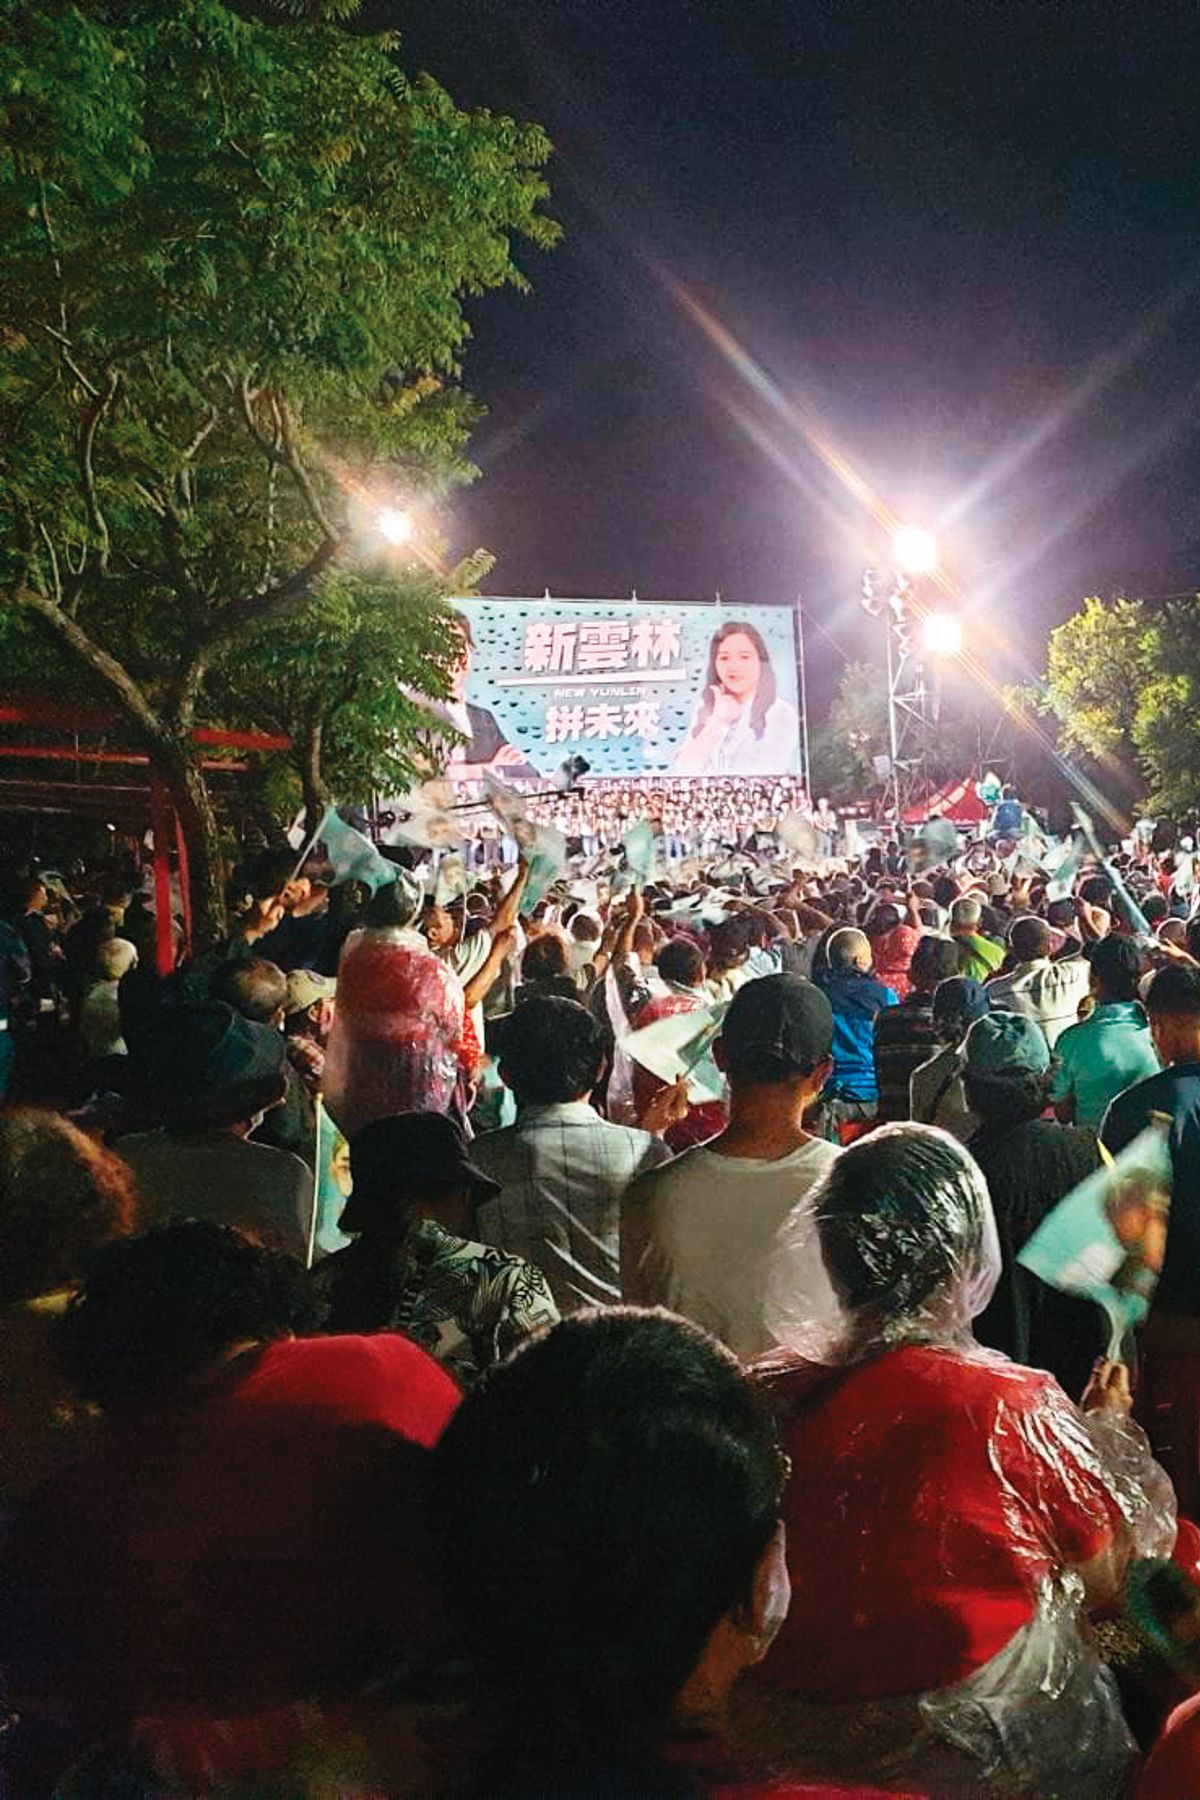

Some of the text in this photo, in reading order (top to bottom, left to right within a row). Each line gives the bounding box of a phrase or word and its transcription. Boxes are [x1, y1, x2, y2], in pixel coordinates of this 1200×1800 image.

[524, 618, 682, 674] 新雲林
[553, 685, 647, 699] NEW YUNLIN
[545, 701, 661, 744] 拼未來
